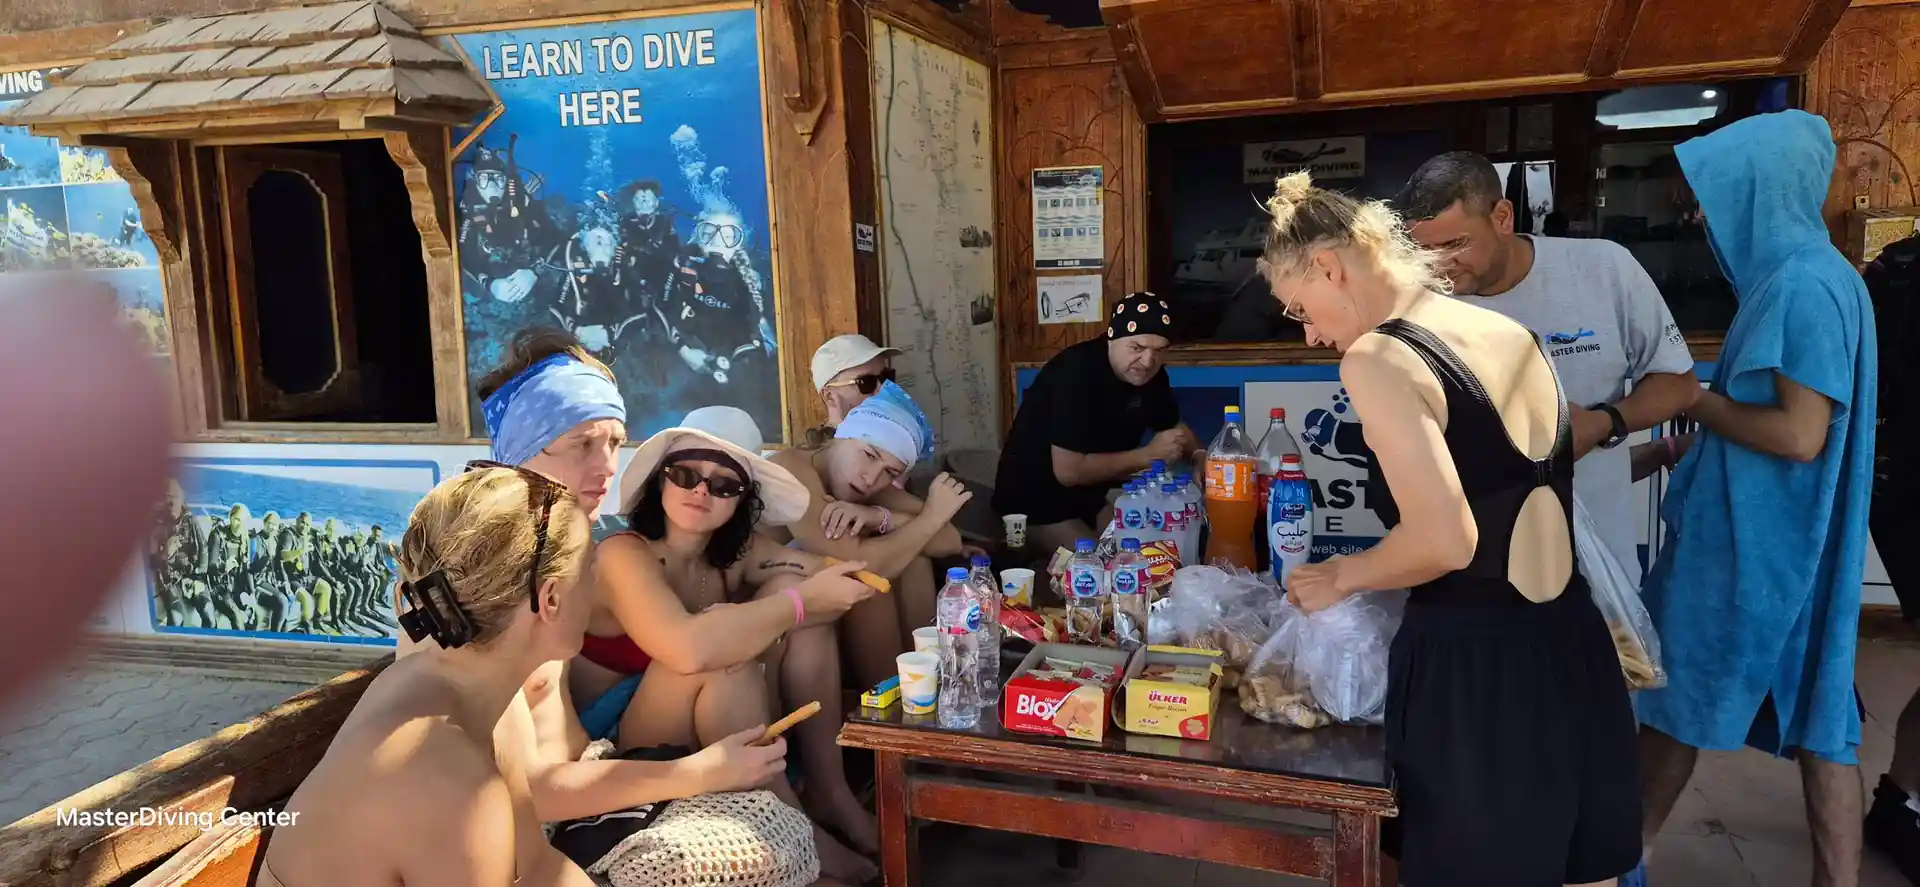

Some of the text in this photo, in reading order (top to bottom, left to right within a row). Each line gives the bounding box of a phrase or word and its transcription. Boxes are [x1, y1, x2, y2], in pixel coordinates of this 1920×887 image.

[484, 29, 716, 80] LEARN TO DIVE
[559, 88, 642, 127] HERE
[1311, 162, 1361, 173] DIVING
[1551, 343, 1601, 357] ASTER DIVING
[1311, 543, 1337, 554] web
[1148, 690, 1188, 705] ÜLKER
[1016, 693, 1060, 721] Blox
